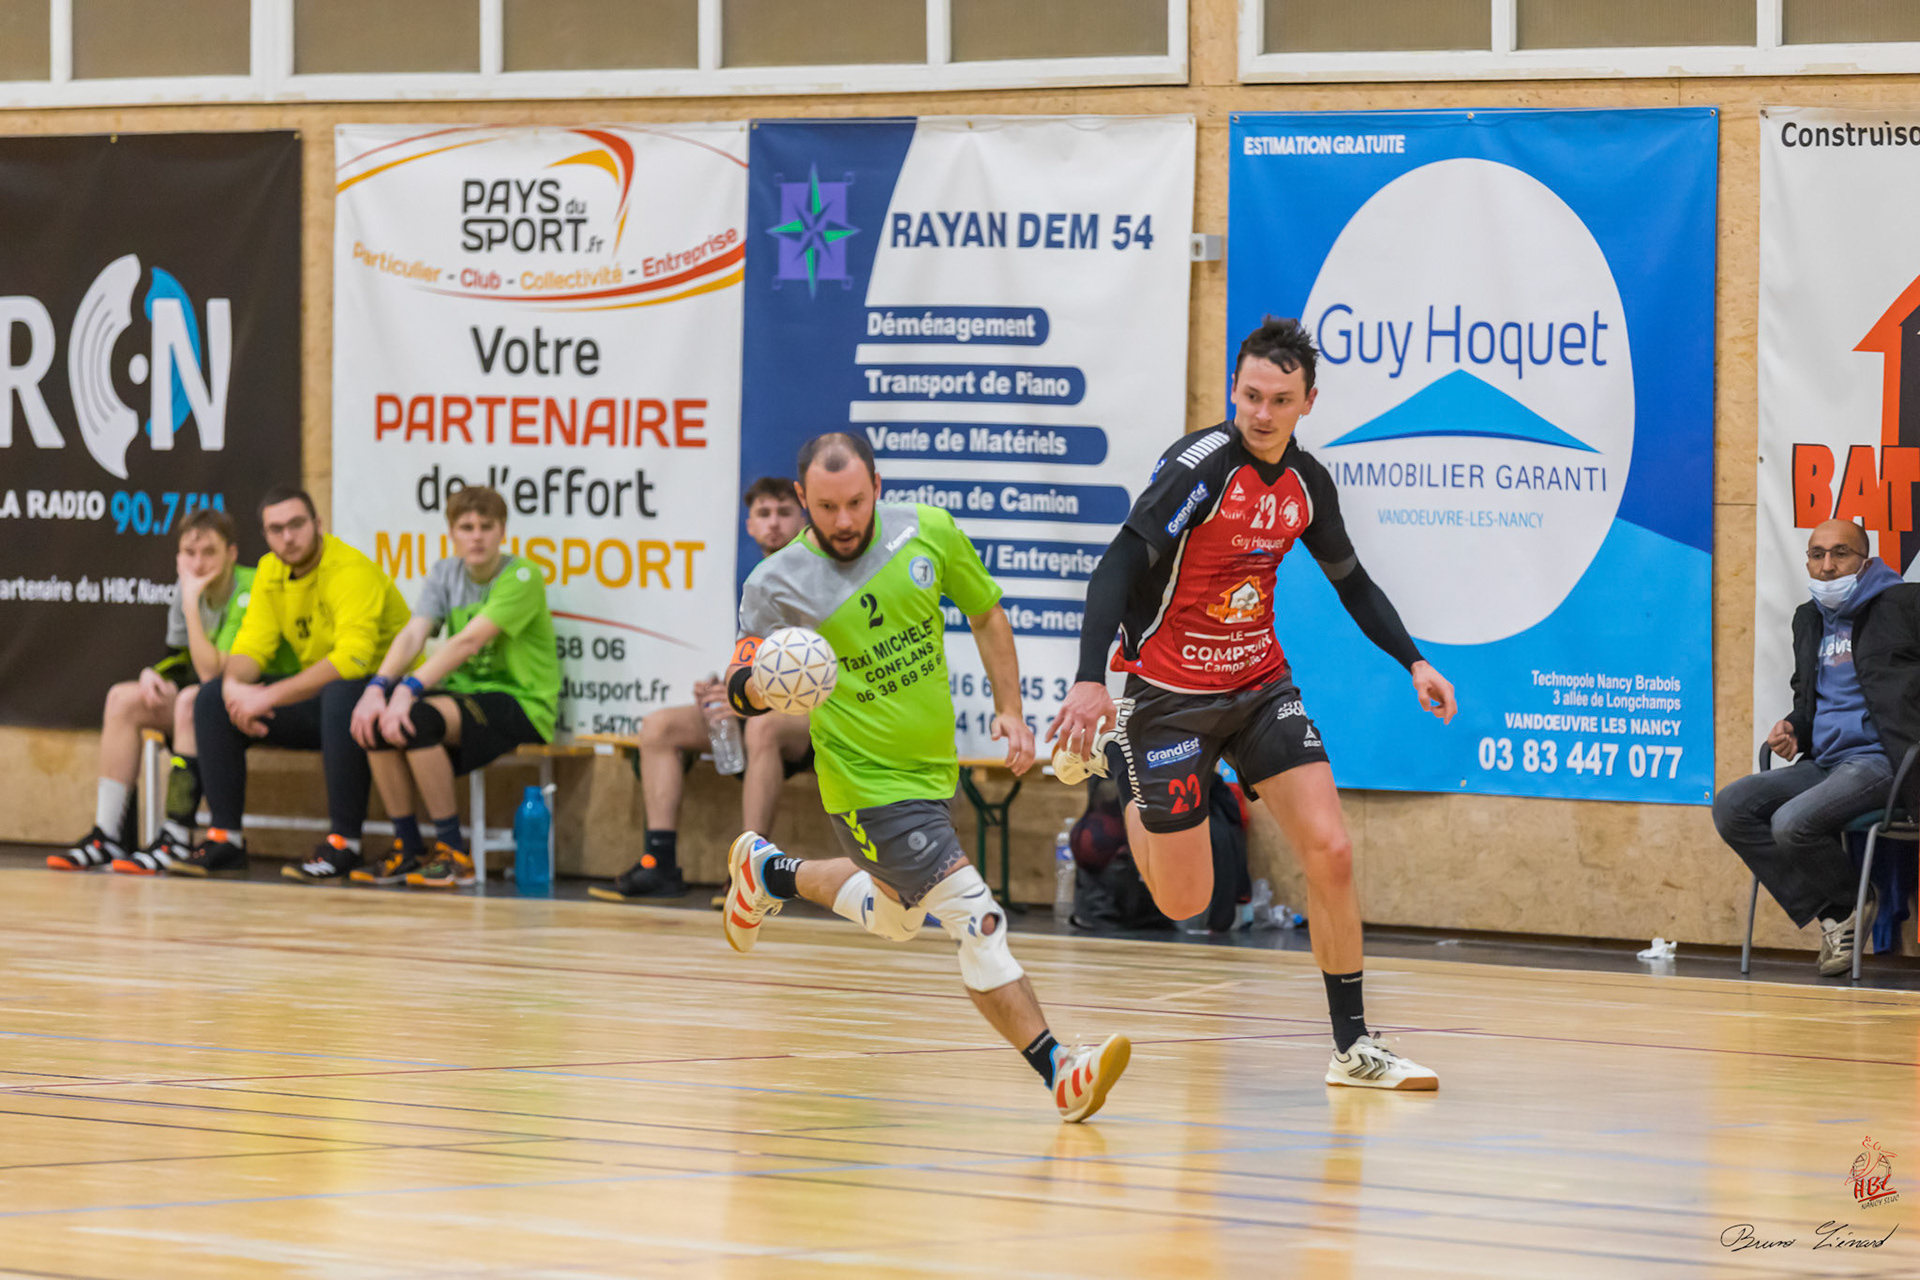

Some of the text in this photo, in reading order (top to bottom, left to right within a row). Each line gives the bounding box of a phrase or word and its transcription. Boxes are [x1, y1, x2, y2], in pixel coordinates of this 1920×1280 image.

[1243, 134, 1406, 155] ESTIMATION GRATUITE
[462, 179, 587, 214] PAYS du
[890, 212, 1154, 250] RAYAN DEM 54
[353, 240, 441, 283] Particulier
[460, 268, 502, 289] Club
[520, 261, 623, 291] Collectivité
[642, 226, 739, 279] Entreprise
[867, 312, 1036, 342] Déménagement
[1316, 303, 1609, 380] Guy Hoquet
[470, 325, 600, 376] Votre
[864, 369, 1071, 399] Transport de Piano
[374, 393, 708, 448] PARTENAIRE
[866, 426, 1068, 456] Vente de Matériels
[1495, 465, 1607, 492] GARANTI
[1793, 443, 1920, 532] BAT
[0, 489, 21, 519] A
[26, 490, 106, 520] RADIO
[110, 491, 181, 536] 90.7
[880, 485, 1079, 514] ocation de Camion
[1250, 493, 1277, 530] 29
[1377, 508, 1544, 529] VANDOEUVRE-LES-NANCY
[1231, 534, 1251, 550] Guy
[375, 531, 705, 590] MUSPORT
[0, 575, 177, 606] artenaire du HBC Nanc
[860, 593, 884, 629] 2
[592, 638, 625, 661] 06
[739, 641, 755, 662] C
[1230, 631, 1244, 642] LE
[840, 649, 873, 672] Taxi
[865, 641, 934, 683] CONFLANS
[856, 689, 876, 703] 06
[878, 680, 898, 697] 38
[901, 670, 919, 687] 69
[920, 661, 935, 677] 56
[1597, 674, 1632, 694] Nancy
[1635, 674, 1681, 692] Brabois
[1552, 690, 1682, 714] 3 allée de Longchamps
[1601, 717, 1627, 735] LES
[1630, 719, 1682, 737] NANCY
[1478, 736, 1684, 780] 03 83 447 077
[1168, 773, 1201, 815] 29
